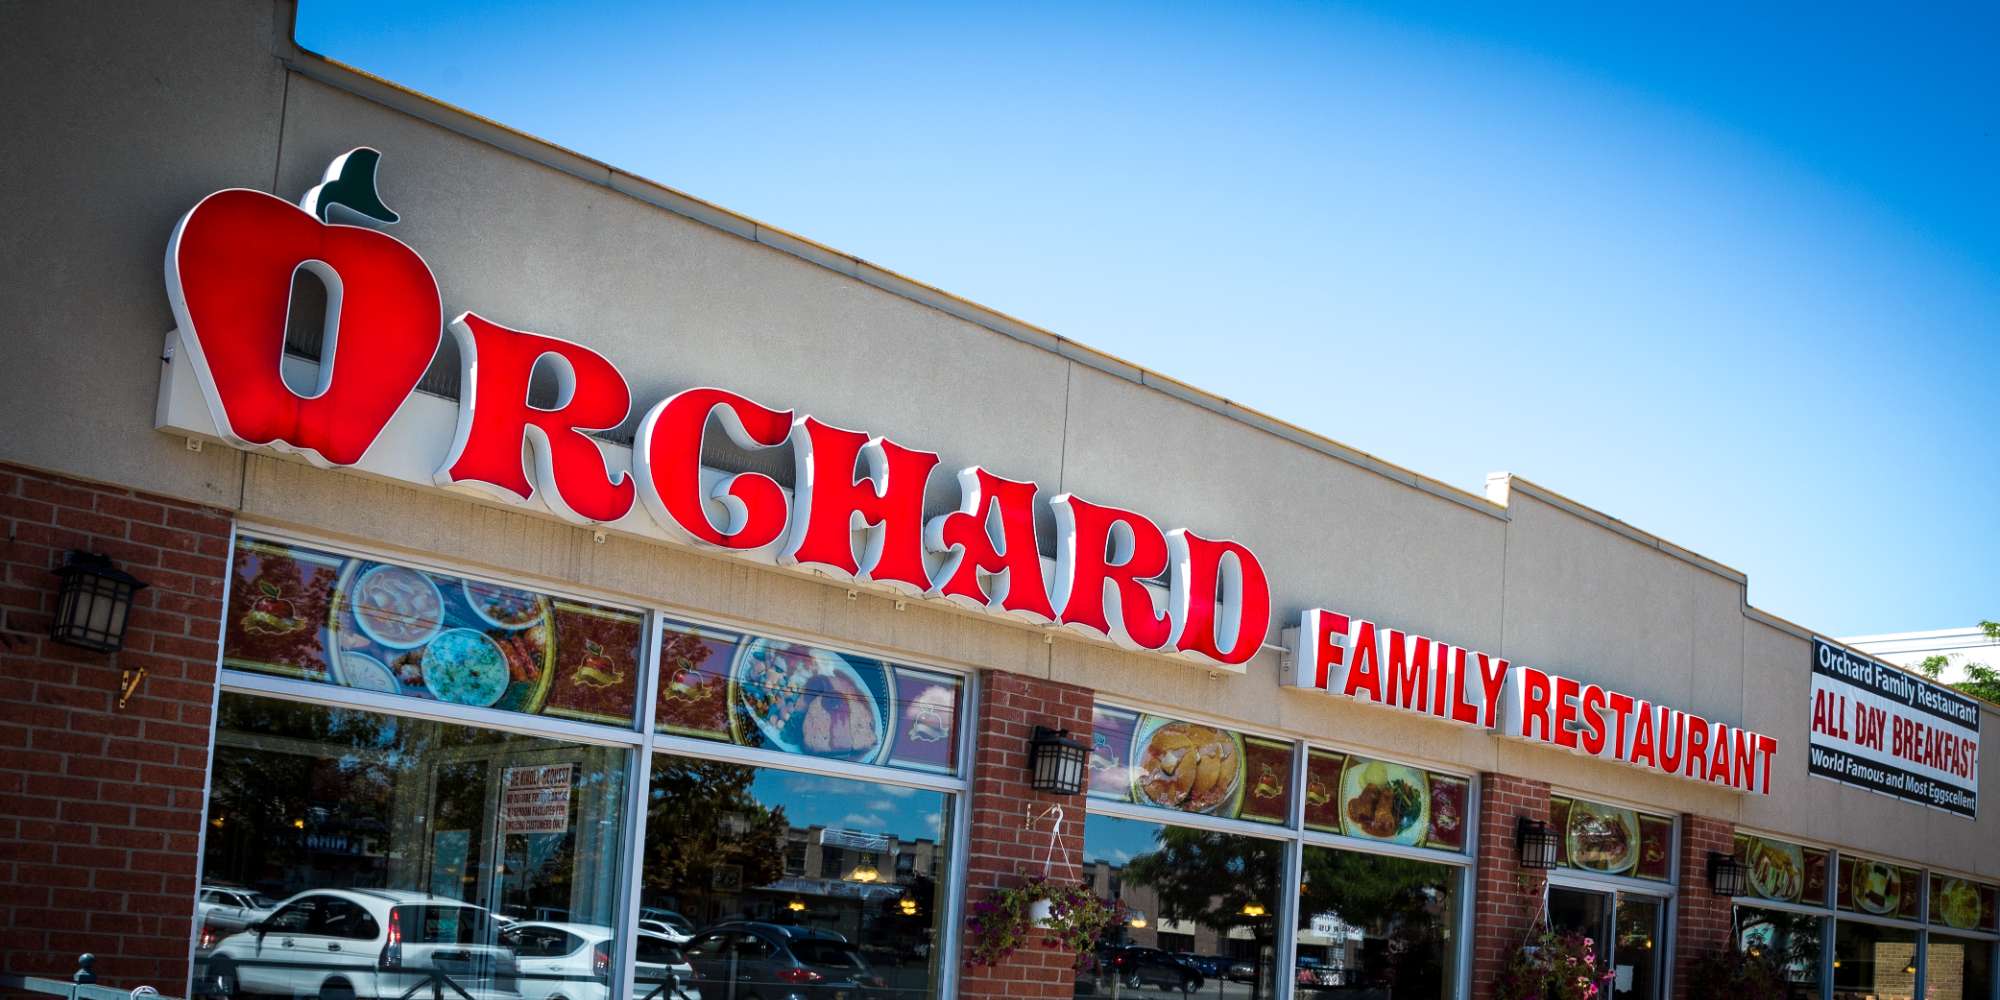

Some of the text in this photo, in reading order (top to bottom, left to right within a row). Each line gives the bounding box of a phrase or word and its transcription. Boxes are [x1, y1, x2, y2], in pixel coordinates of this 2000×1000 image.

[174, 186, 1271, 670] ORCHARD
[1312, 608, 1777, 795] FAMILY RESTAURANT
[1819, 644, 1977, 725] Orchard Family Restaurant
[1811, 747, 1976, 811] World Famous and Most Eggscellent
[1812, 688, 1977, 782] ALL DAY BREAKFAST
